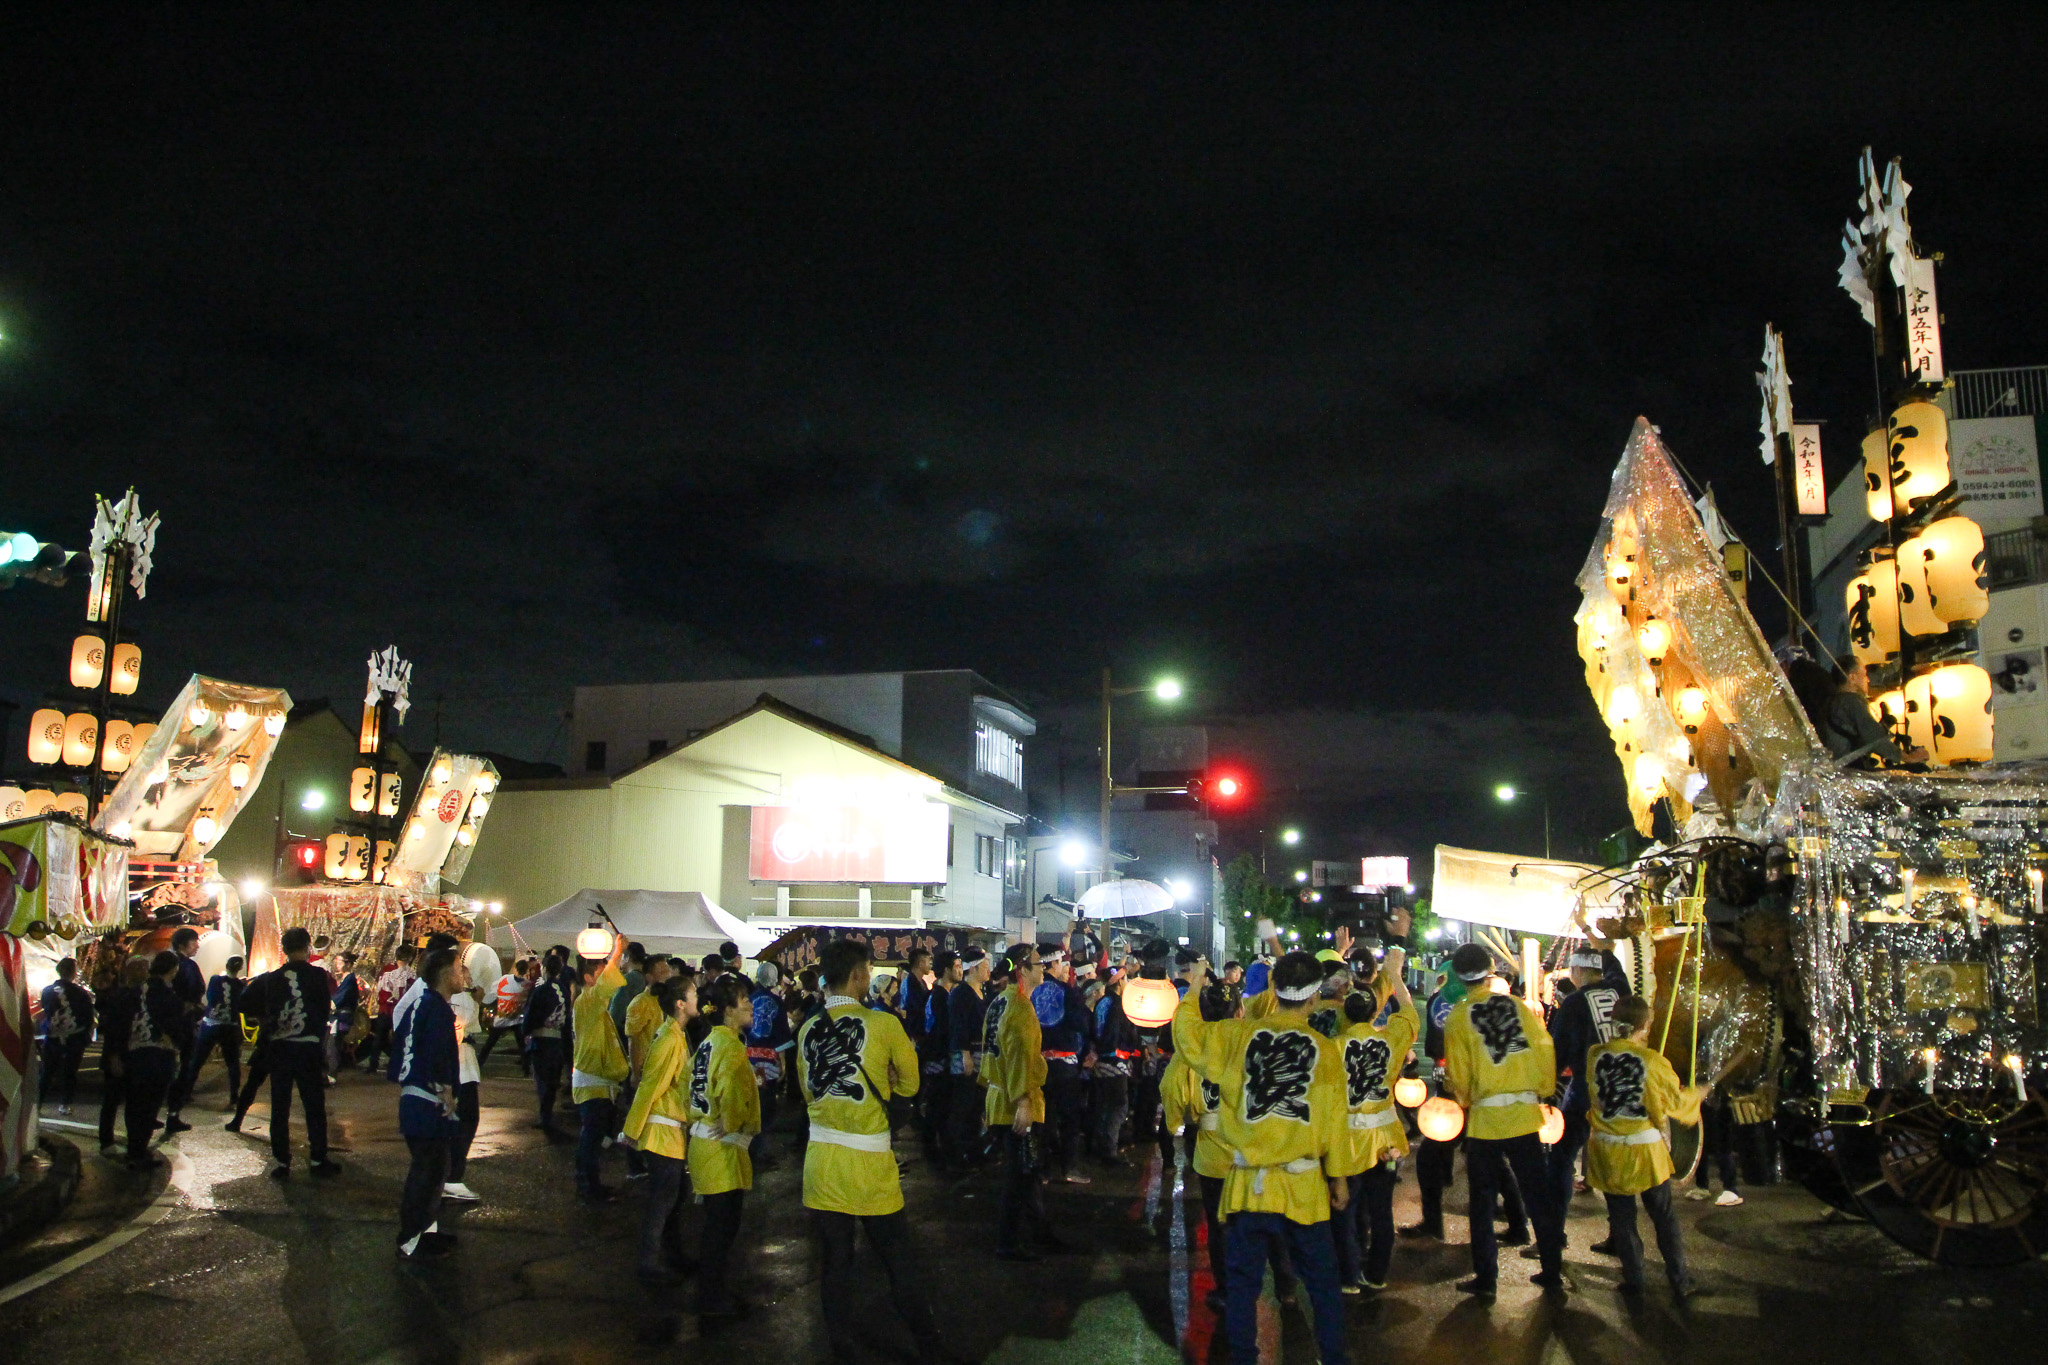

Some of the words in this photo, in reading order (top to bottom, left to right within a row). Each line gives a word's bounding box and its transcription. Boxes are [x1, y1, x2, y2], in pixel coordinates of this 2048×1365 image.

[1908, 286, 1934, 372] 令和五年八月
[1799, 436, 1818, 500] 令和五年八月
[1994, 467, 2029, 475] HOSPITAL
